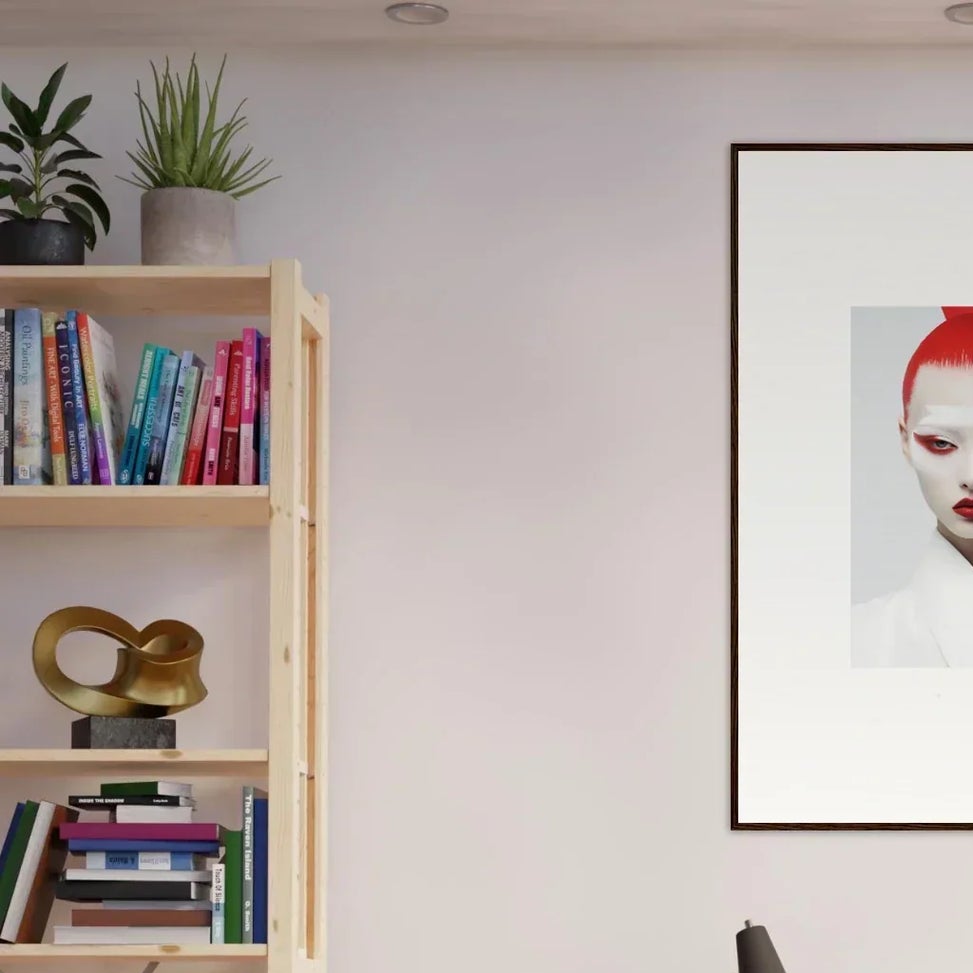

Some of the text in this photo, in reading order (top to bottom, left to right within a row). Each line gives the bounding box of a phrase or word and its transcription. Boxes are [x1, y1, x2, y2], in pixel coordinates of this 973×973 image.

[18, 325, 32, 385] Oil Paintings
[60, 344, 73, 408] ICONIC
[50, 384, 58, 401] With
[50, 403, 60, 424] Digital
[53, 426, 61, 442] Tools
[244, 850, 252, 880] Island
